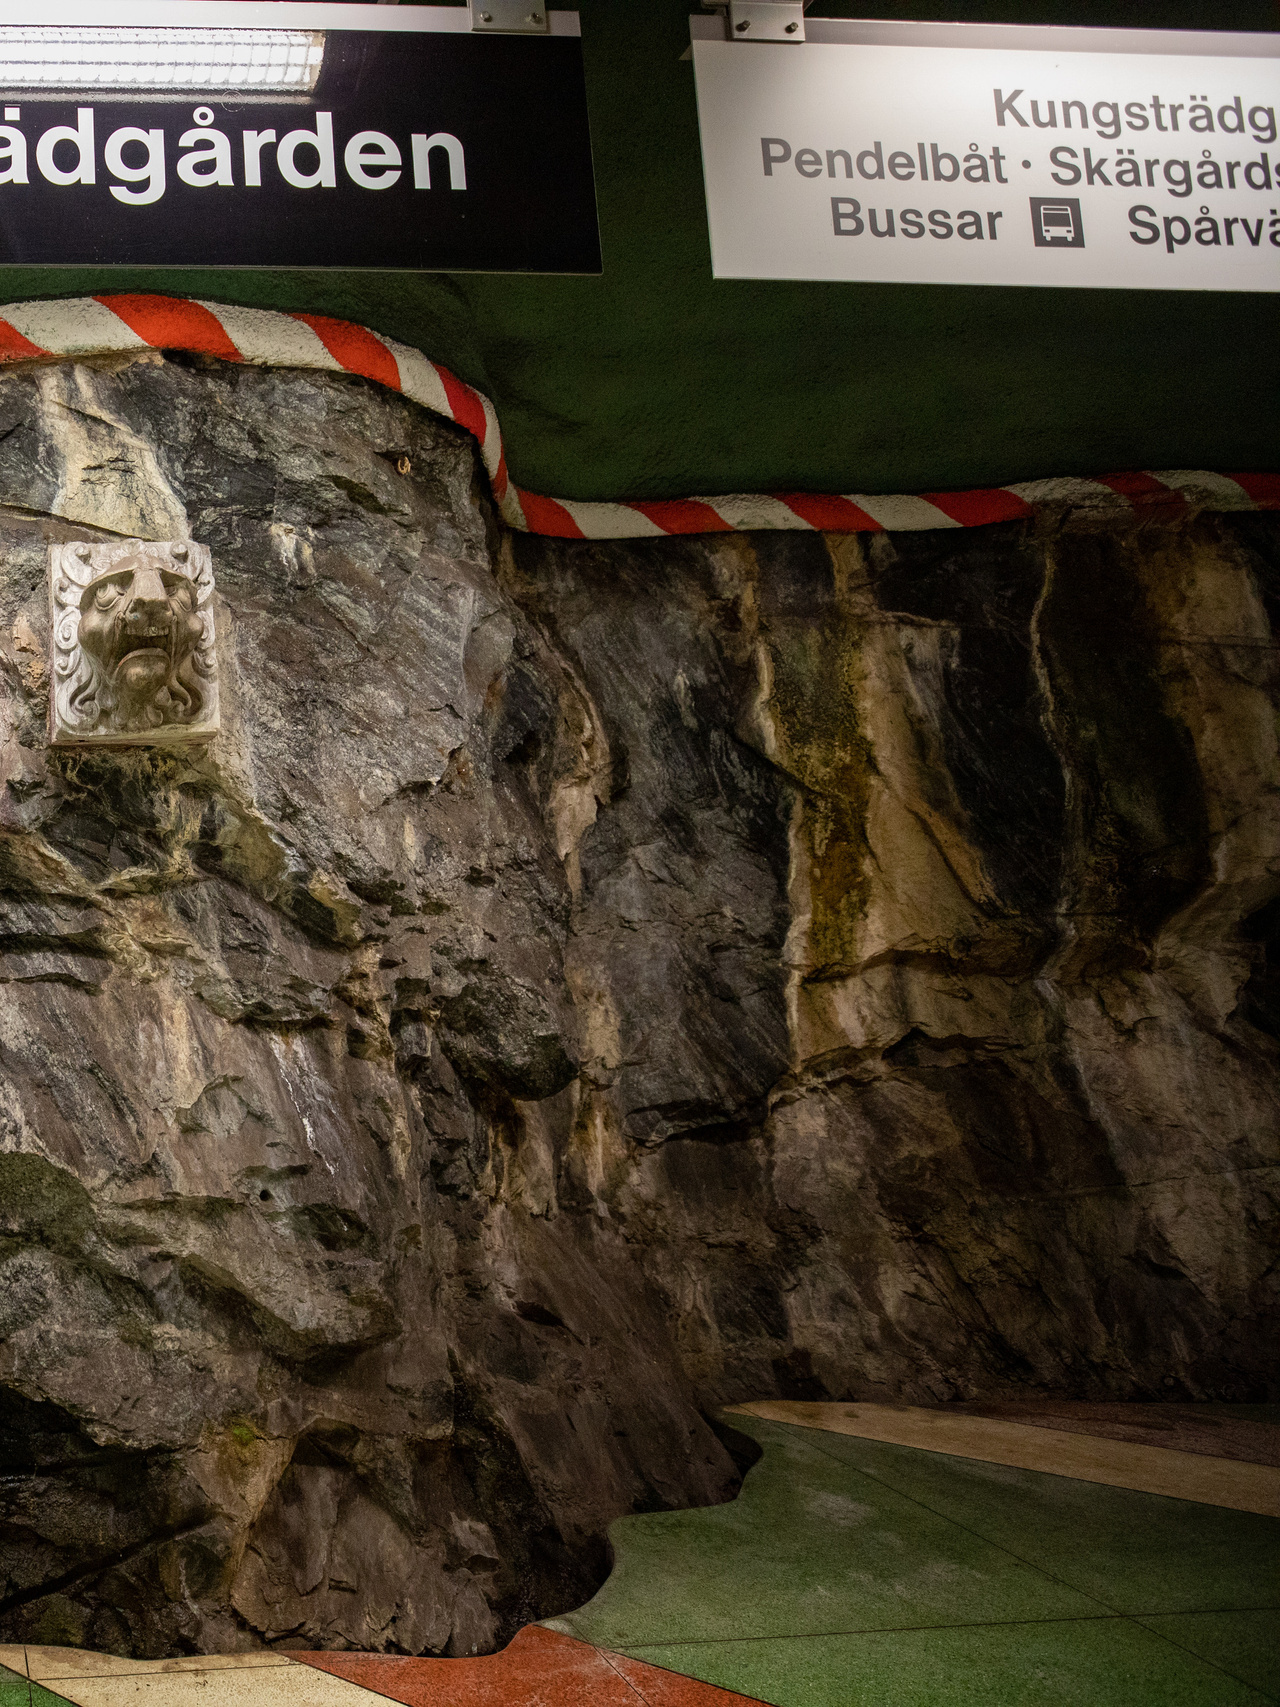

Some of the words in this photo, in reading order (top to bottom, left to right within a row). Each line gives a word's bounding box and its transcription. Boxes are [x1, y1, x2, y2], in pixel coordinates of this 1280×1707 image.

[993, 88, 1278, 145] Kungsträdg
[760, 137, 1009, 184] Pendelbåt
[1049, 145, 1280, 198] Skärgård
[830, 196, 1003, 241] Bussar
